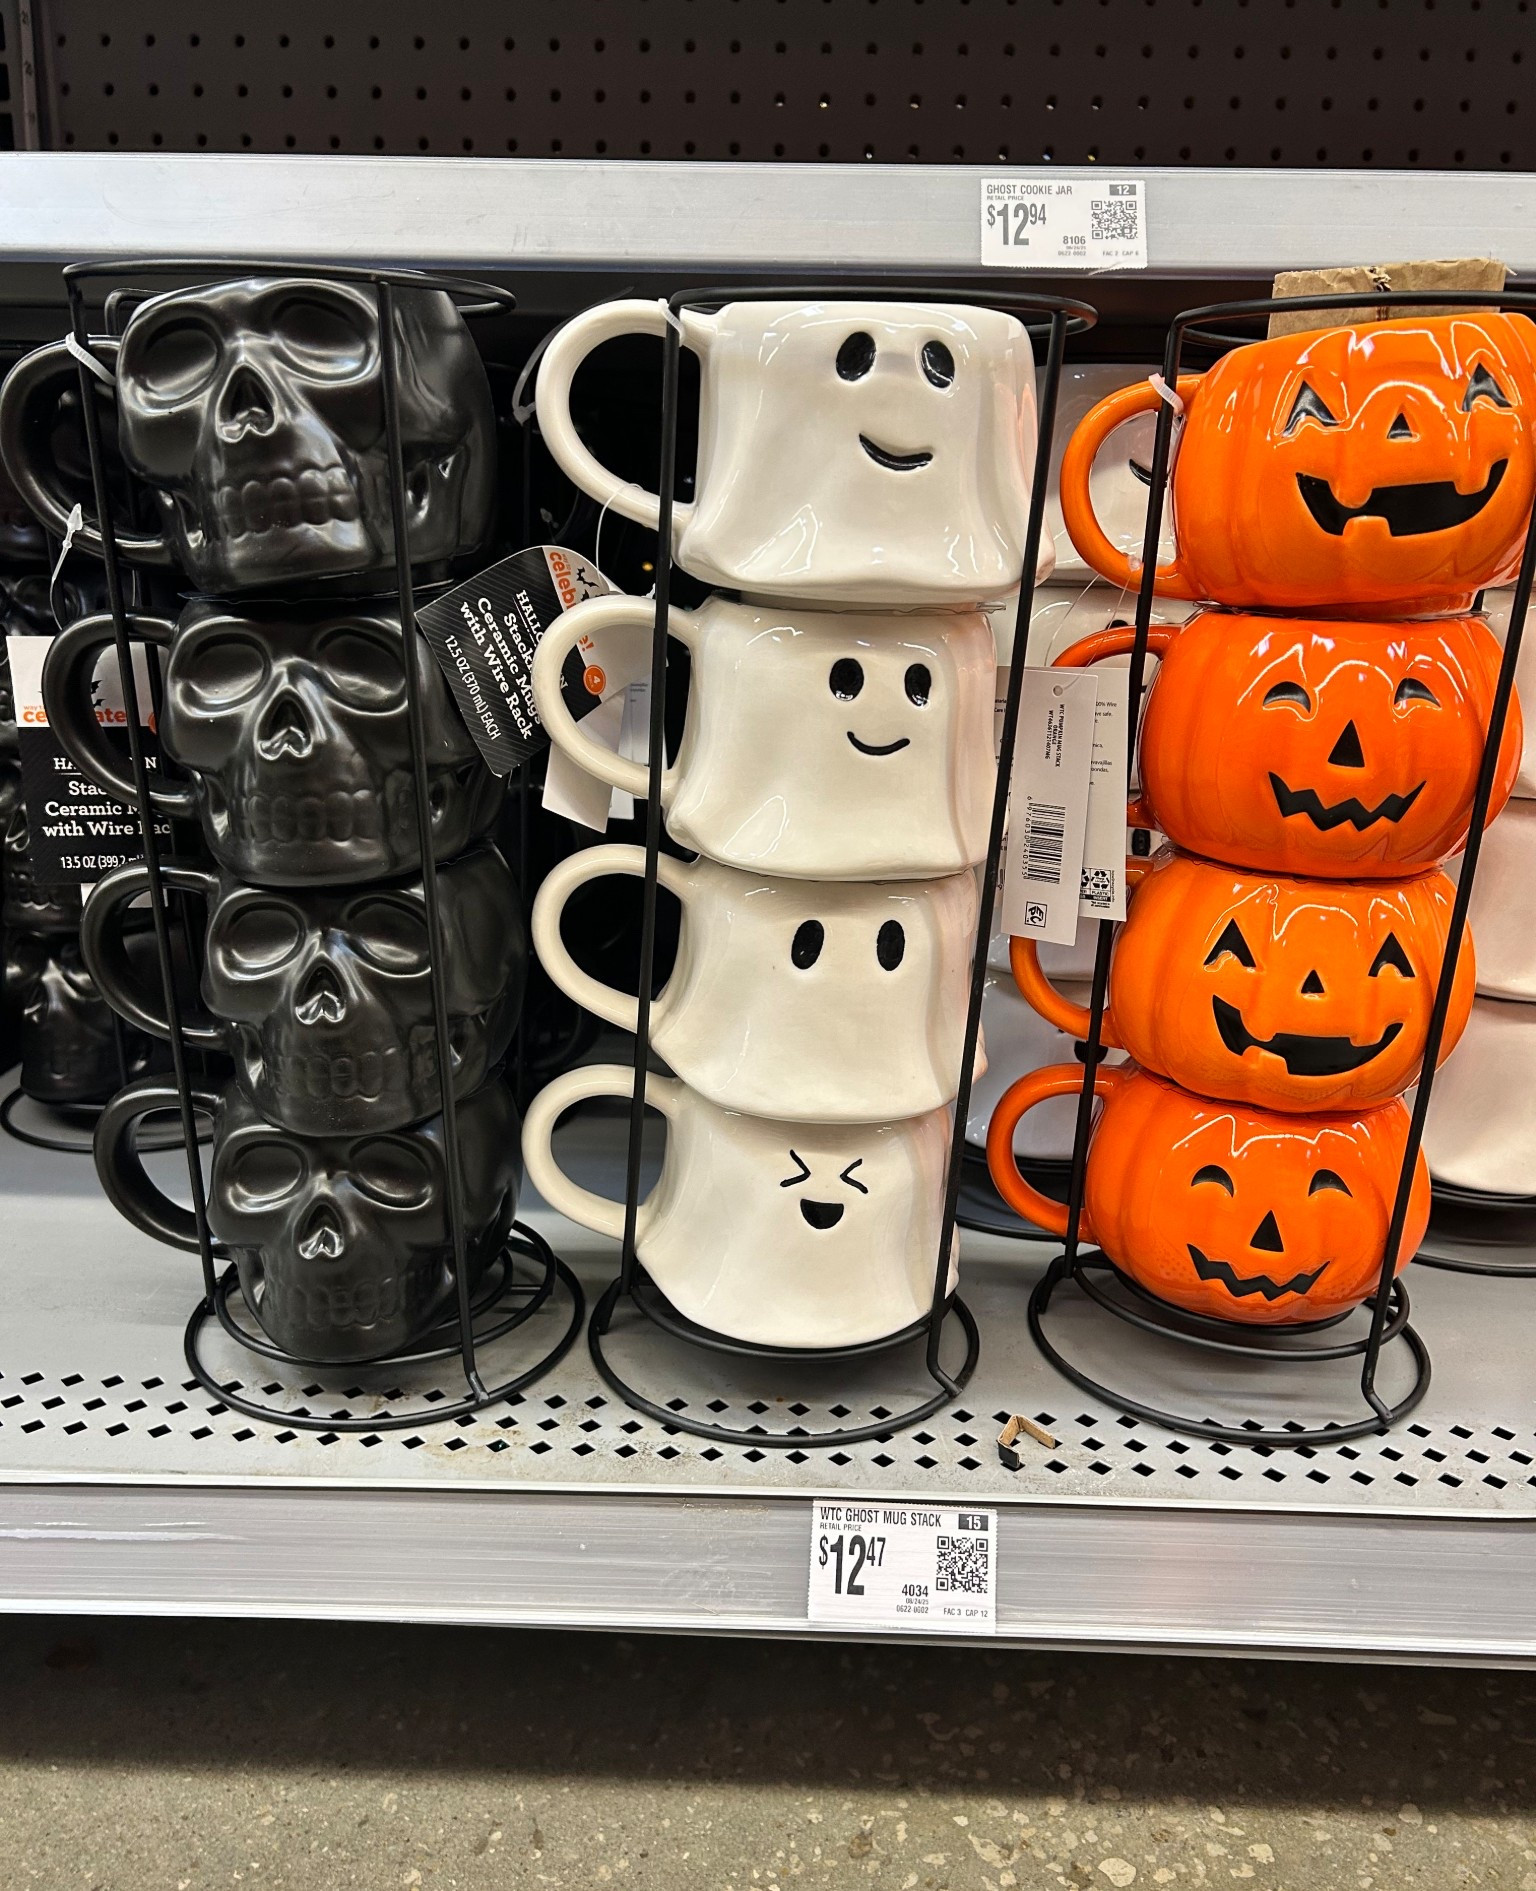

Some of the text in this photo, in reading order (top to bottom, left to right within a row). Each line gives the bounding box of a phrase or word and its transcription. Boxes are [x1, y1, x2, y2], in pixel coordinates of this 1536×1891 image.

[986, 184, 1073, 196] GHOST COOKIE JAR
[1116, 185, 1131, 195] 12
[1062, 235, 1086, 245] 8106
[477, 597, 543, 725] Ceramic Mugs
[460, 601, 533, 740] with Wire Rack
[592, 675, 600, 684] 4
[444, 634, 502, 741] 12.5 OZ (370 mL) EACH
[1057, 715, 1065, 740] PUMPKIN
[1054, 751, 1062, 768] STACK
[45, 801, 123, 817] Ceramic
[42, 820, 85, 838] with
[90, 821, 134, 836] Wire
[60, 856, 81, 869] 13.5
[83, 855, 97, 869] OZ
[820, 1506, 942, 1528] WTC GHOST MUG STACK
[965, 1515, 982, 1530] 15
[819, 1522, 863, 1532] RETAIL PRICE
[901, 1583, 929, 1598] 4034
[896, 1605, 912, 1613] 0622
[943, 1607, 989, 1618] FAC 3 CAP 12
